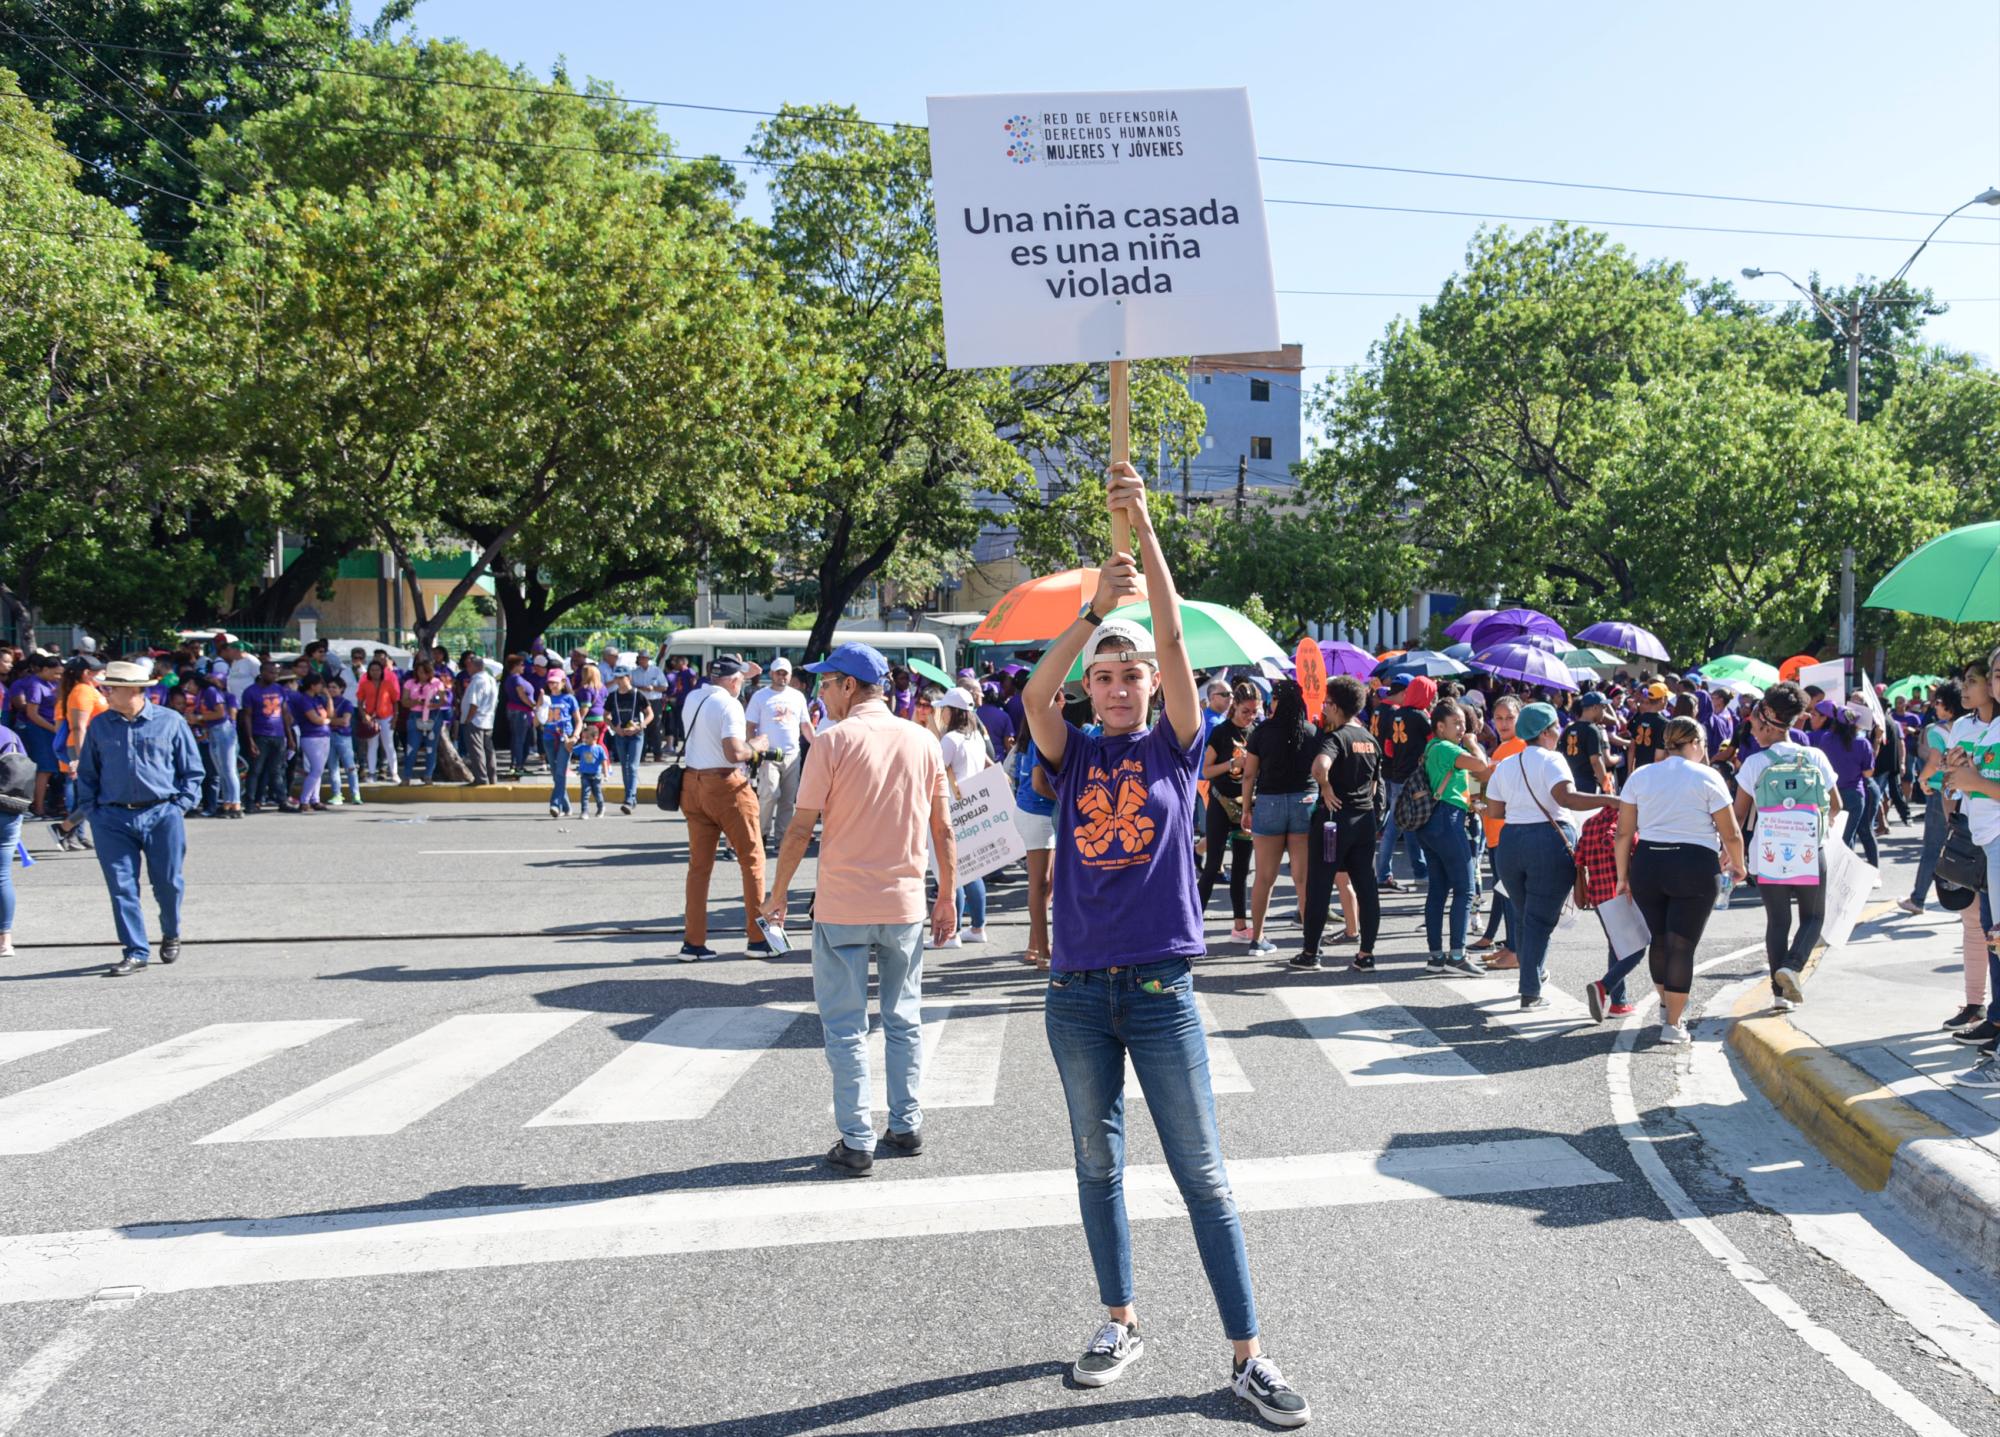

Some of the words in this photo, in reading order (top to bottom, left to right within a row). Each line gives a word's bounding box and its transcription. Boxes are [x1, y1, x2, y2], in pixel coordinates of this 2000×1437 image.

[1044, 113, 1068, 125] RED
[1076, 112, 1092, 125] DE
[1100, 108, 1178, 124] DEFENSORÍA
[1045, 127, 1112, 141] DERECHOS
[1120, 125, 1181, 139] HUMANOS
[1047, 144, 1105, 161] MUJERES
[1112, 143, 1120, 158] Y
[1129, 140, 1184, 158] JÓVENES
[963, 207, 1034, 235] Una
[1043, 203, 1116, 232] niña
[1124, 198, 1240, 229] casada
[1011, 244, 1048, 267] es
[1057, 241, 1120, 264] una
[1128, 232, 1201, 261] niña
[1046, 266, 1173, 299] violada
[979, 787, 990, 797] la
